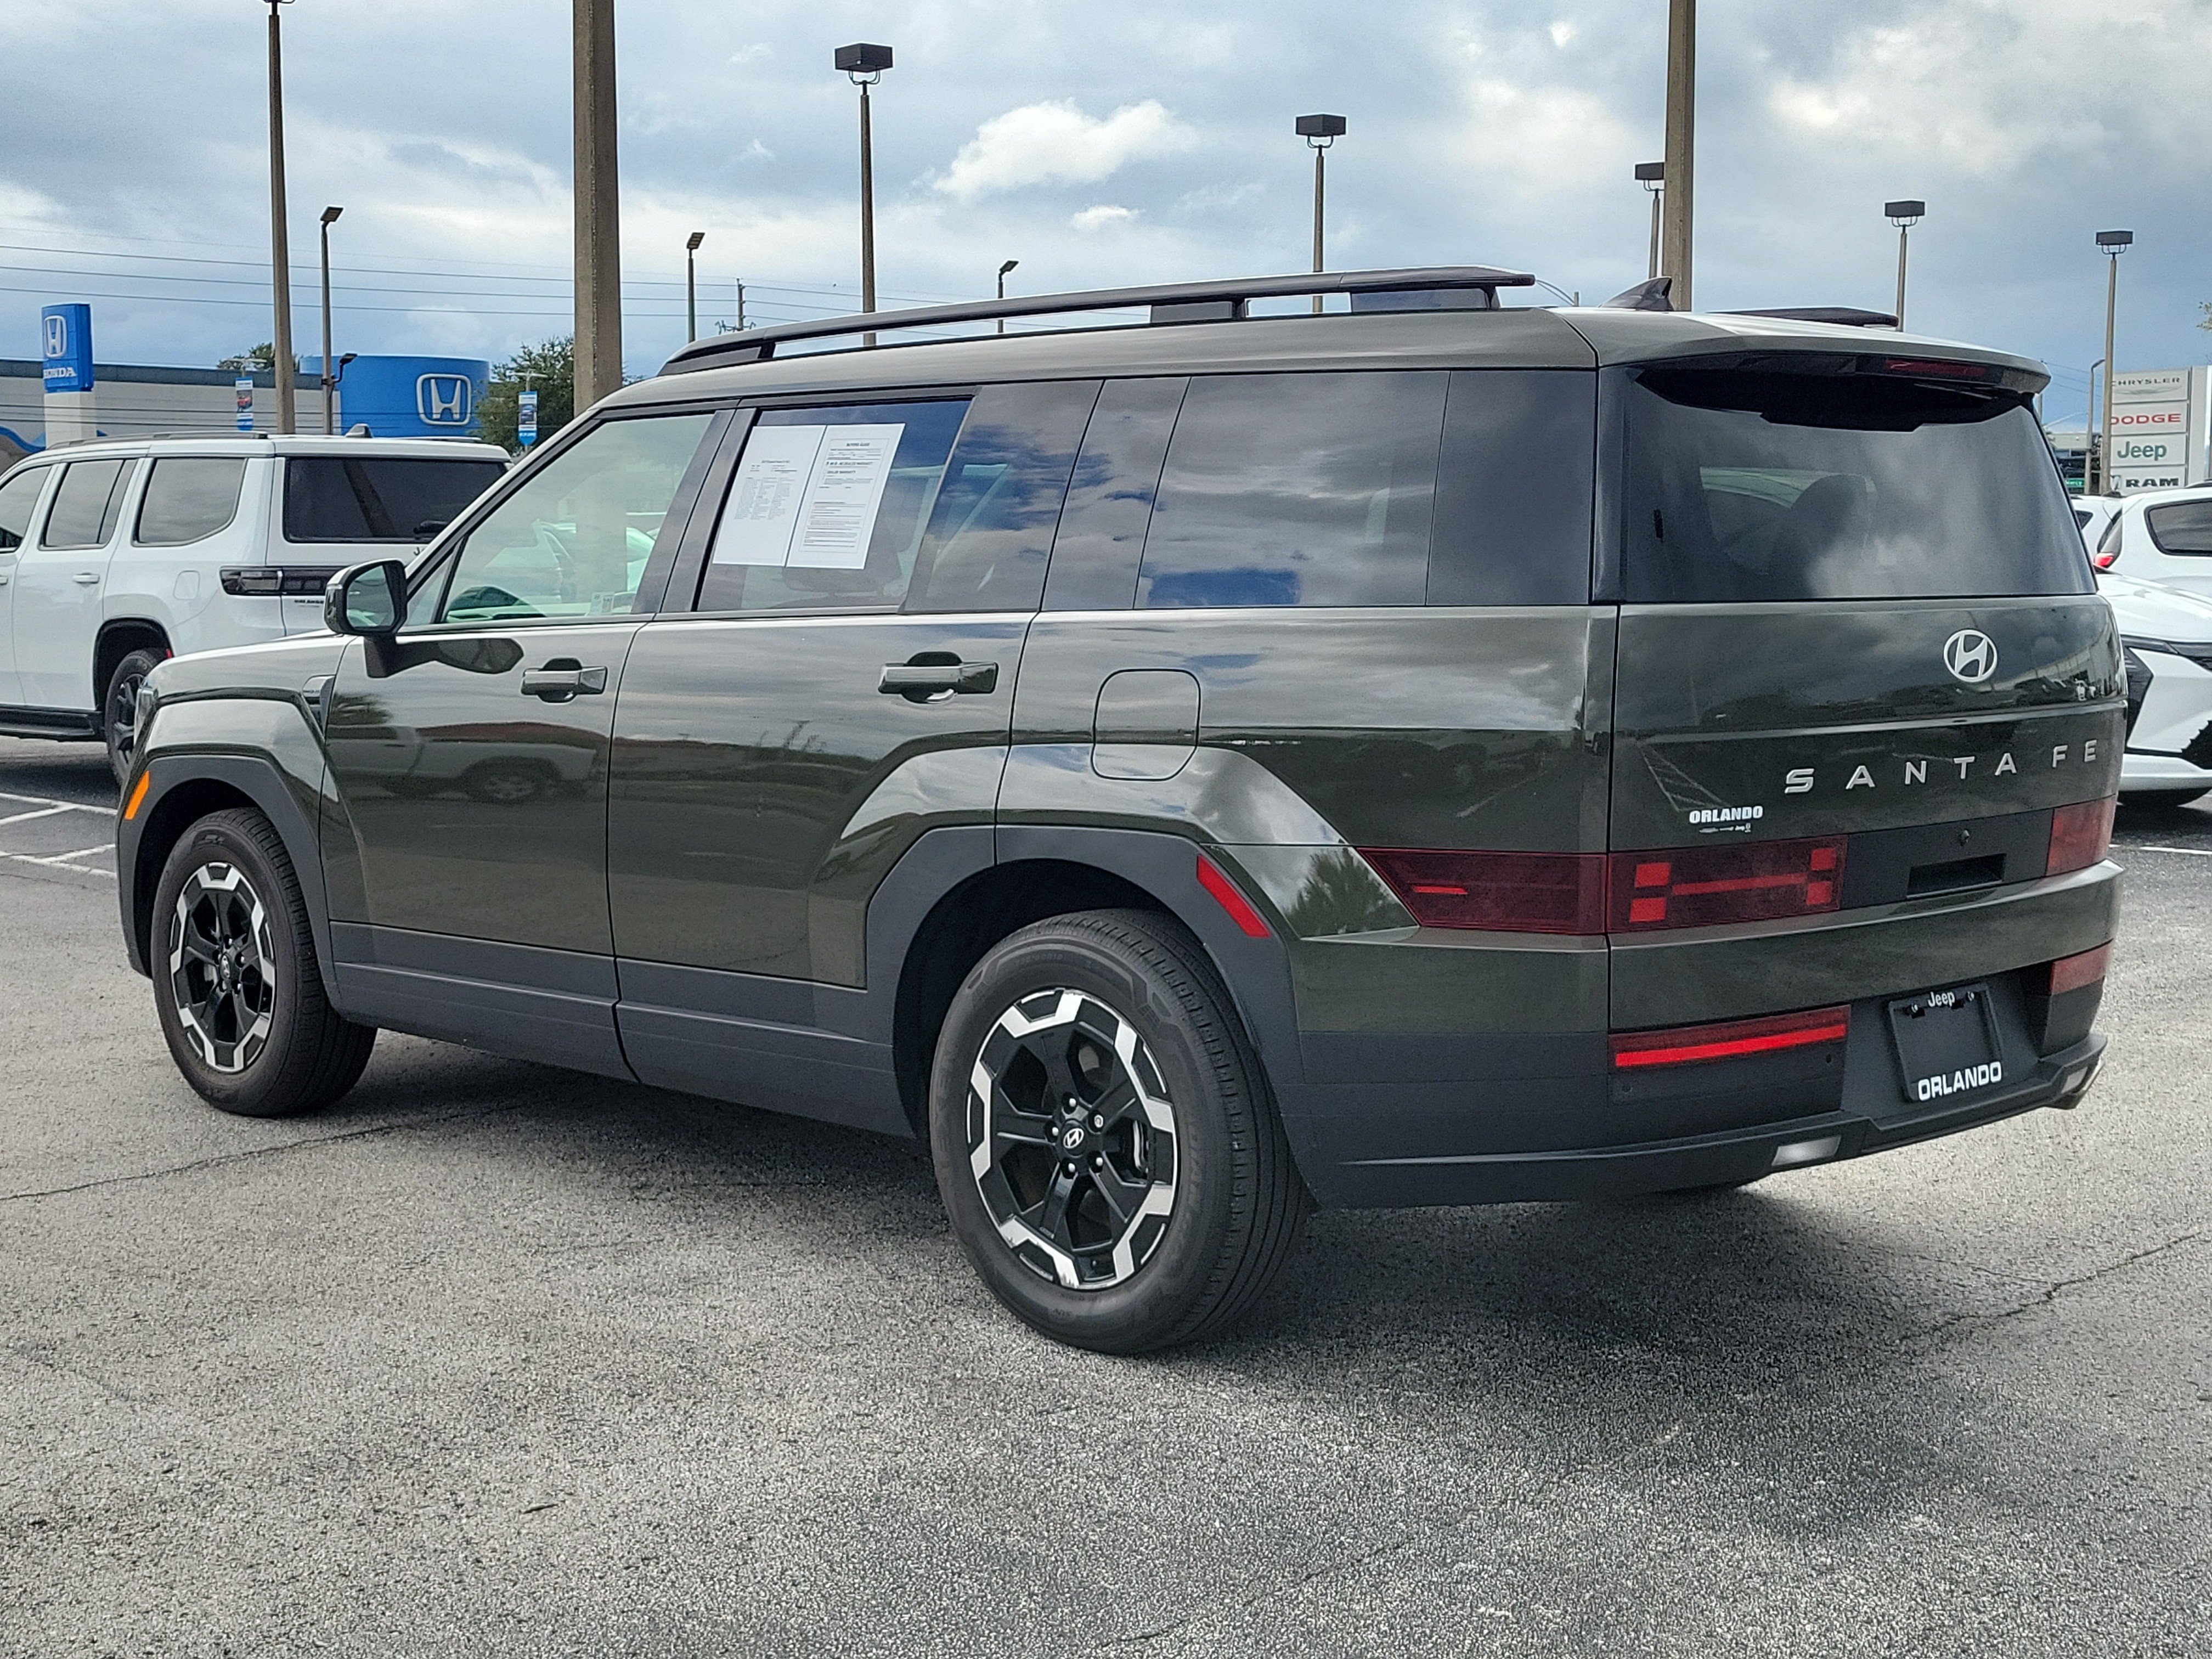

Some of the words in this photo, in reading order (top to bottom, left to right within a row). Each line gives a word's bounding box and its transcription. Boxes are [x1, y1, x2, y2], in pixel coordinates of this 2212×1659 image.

[2117, 441, 2167, 461] Jeep
[2125, 477, 2179, 488] RAM
[1784, 753, 2017, 794] SANTA
[2051, 739, 2098, 769] FE
[1689, 805, 1763, 824] ORLANDO
[1927, 991, 1955, 1008] Jeep
[1918, 1062, 2001, 1101] ORLANDO
